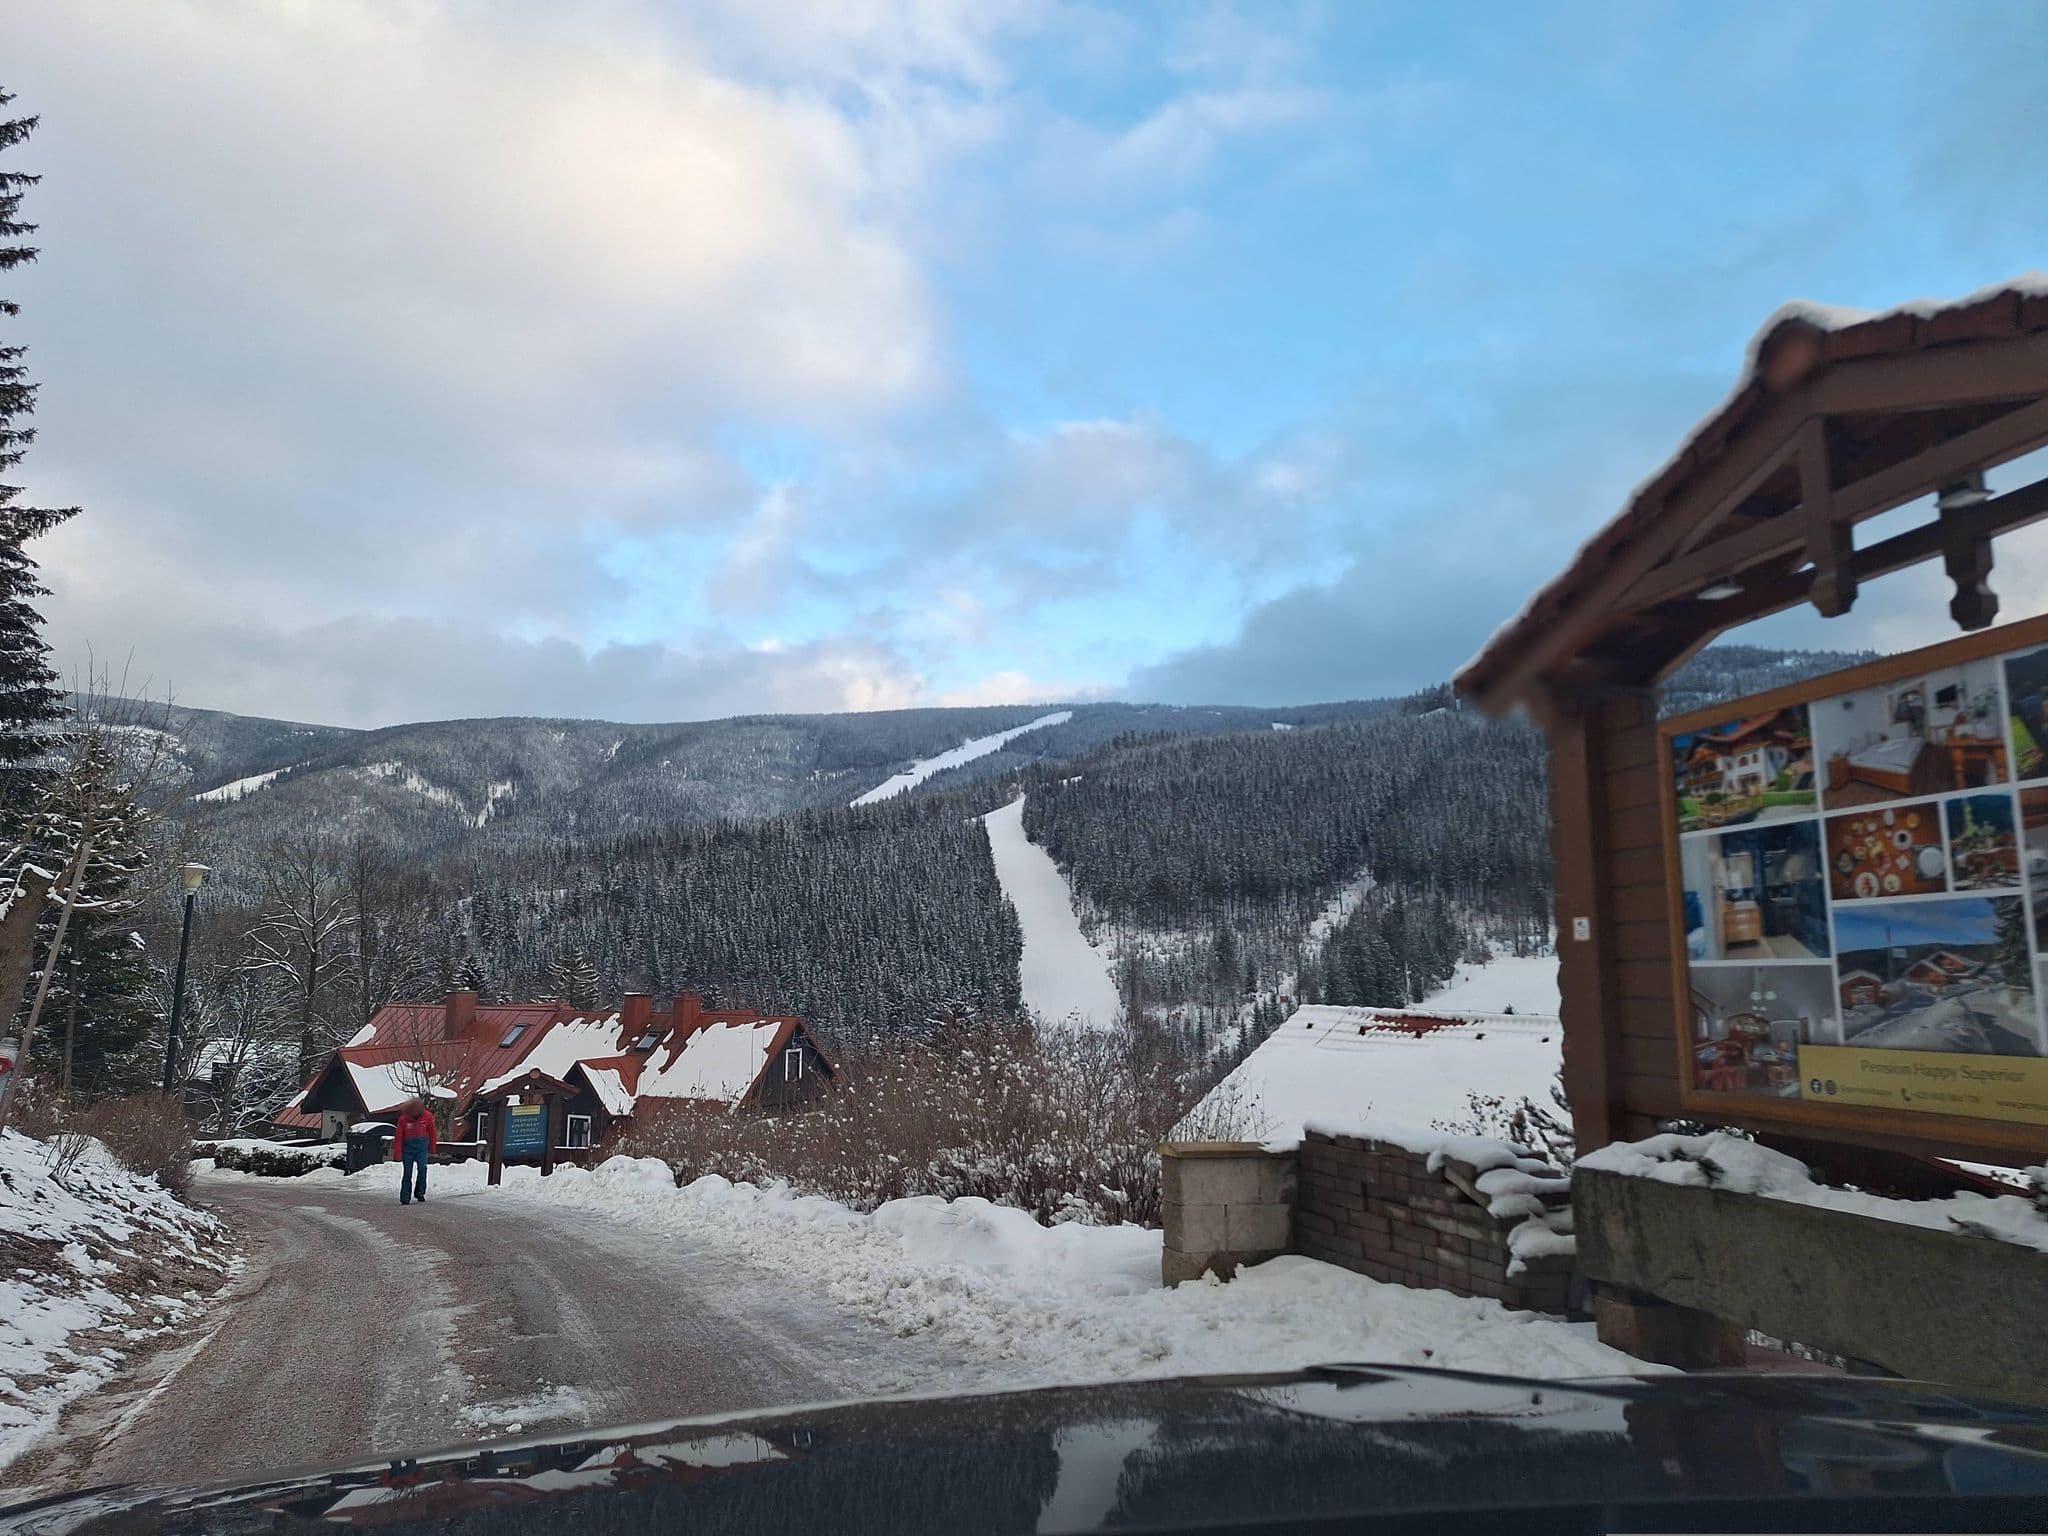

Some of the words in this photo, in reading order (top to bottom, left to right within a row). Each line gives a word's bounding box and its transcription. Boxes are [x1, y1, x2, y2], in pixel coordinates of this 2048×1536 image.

[1861, 1059, 1911, 1075] Pension
[1913, 1062, 1957, 1081] Happy
[1960, 1065, 2026, 1083] Superior
